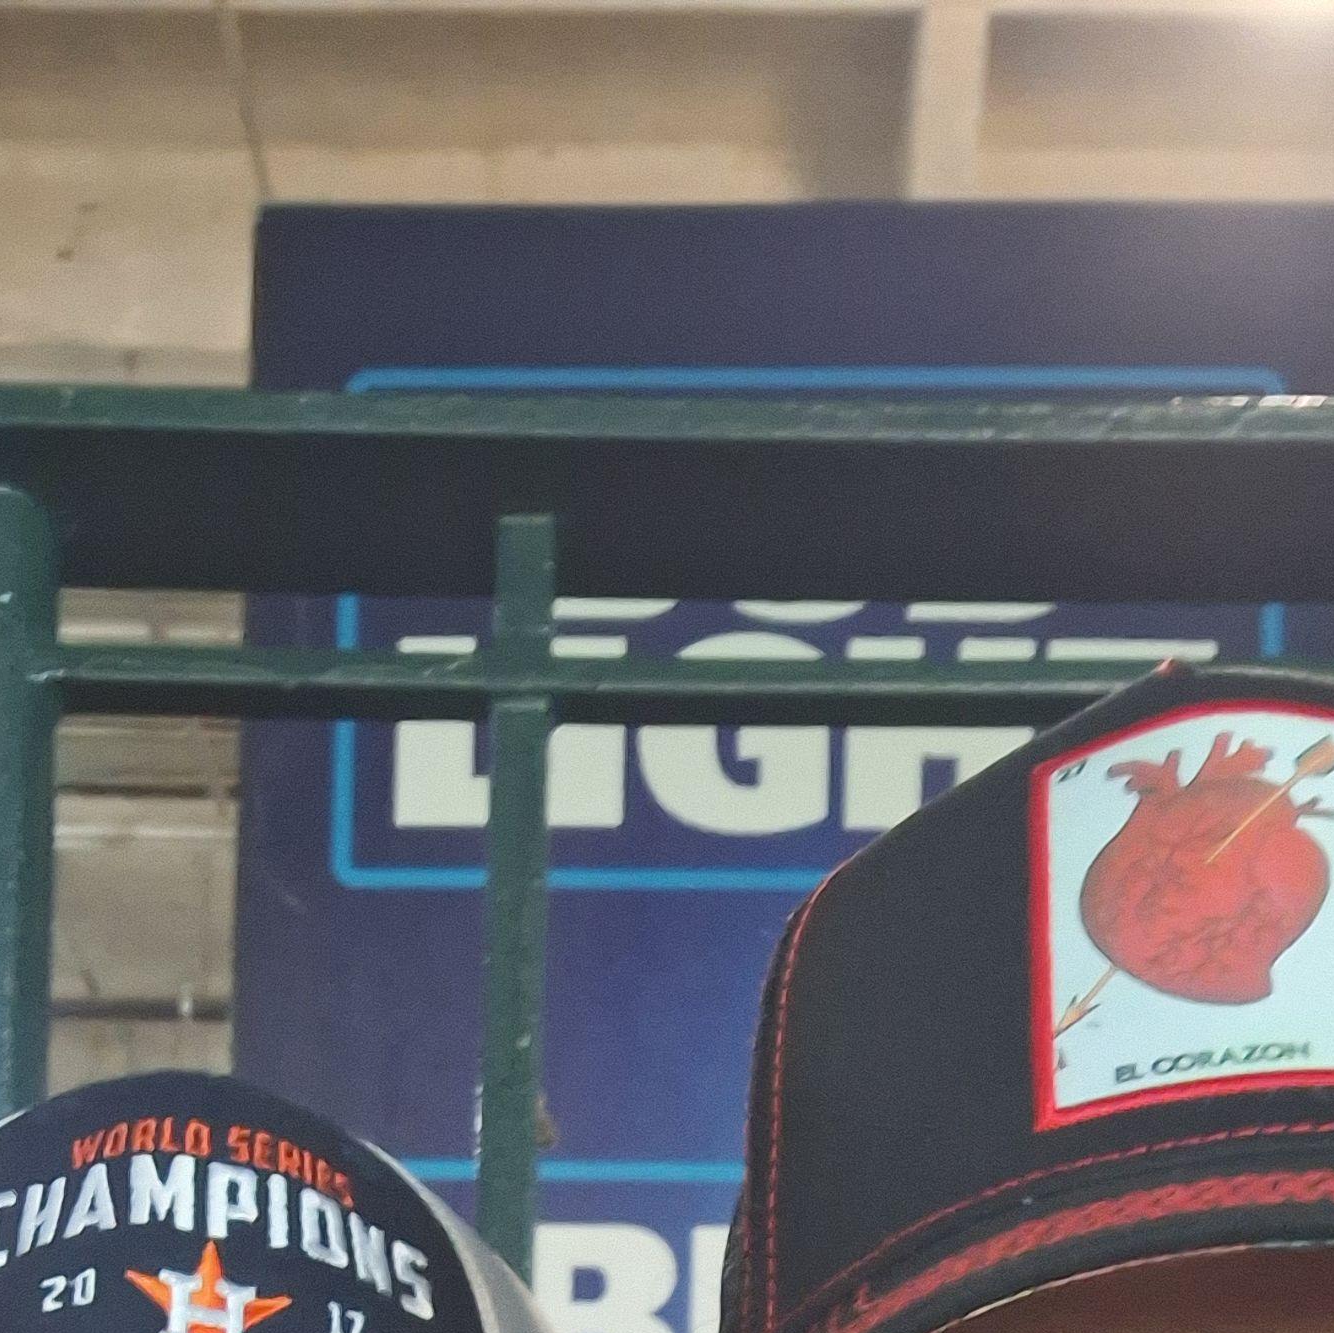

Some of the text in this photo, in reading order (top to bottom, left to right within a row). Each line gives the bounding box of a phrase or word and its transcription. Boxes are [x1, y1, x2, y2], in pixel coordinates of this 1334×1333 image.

[1114, 1040, 1310, 1085] EL CORAZON
[71, 1115, 355, 1209] WORLD SERIES
[39, 1266, 97, 1313] 20
